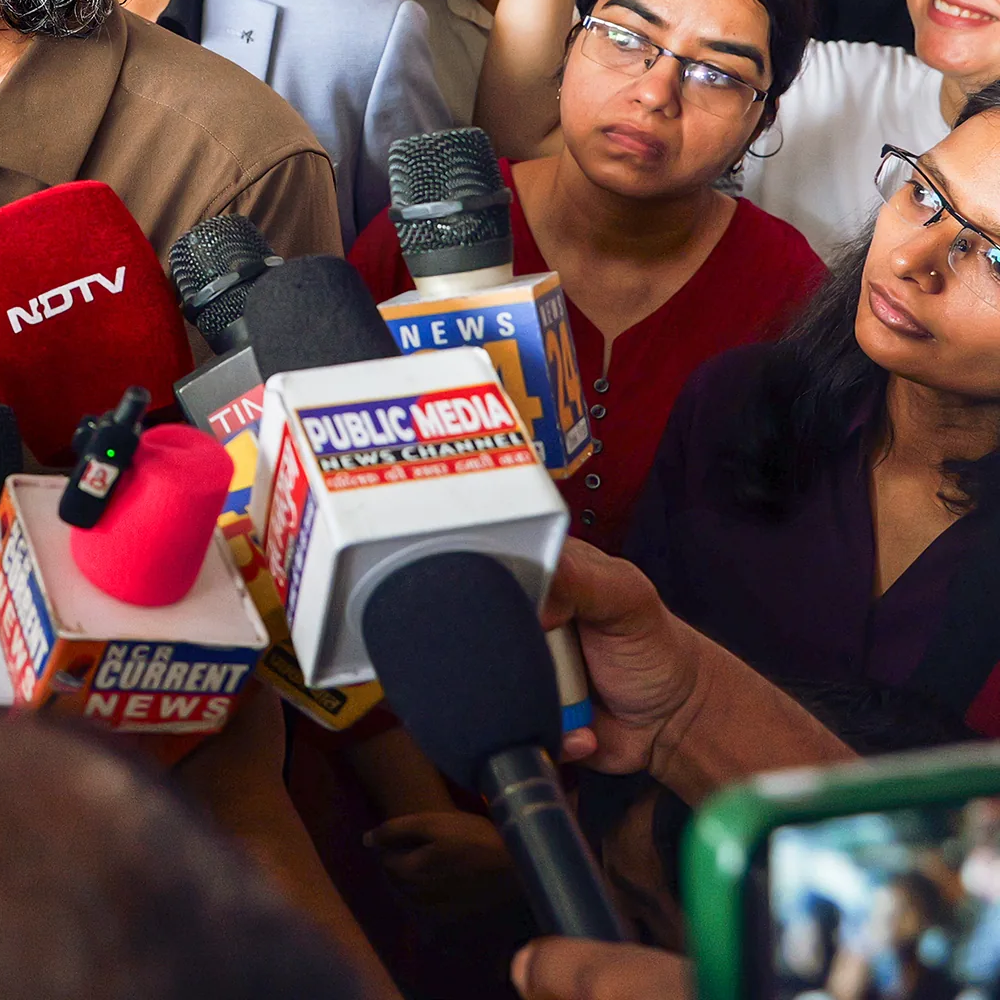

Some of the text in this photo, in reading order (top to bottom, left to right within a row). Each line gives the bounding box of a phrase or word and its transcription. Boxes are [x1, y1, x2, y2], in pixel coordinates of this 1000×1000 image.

[7, 266, 125, 333] NDTV
[400, 312, 515, 350] NEWS
[546, 320, 584, 432] 24
[302, 405, 416, 453] PUBLIC
[410, 392, 515, 439] MEDIA
[320, 450, 397, 472] NEWS
[401, 431, 524, 461] CHANNEL
[95, 660, 249, 693] CURRENT
[83, 693, 231, 720] NEWS
